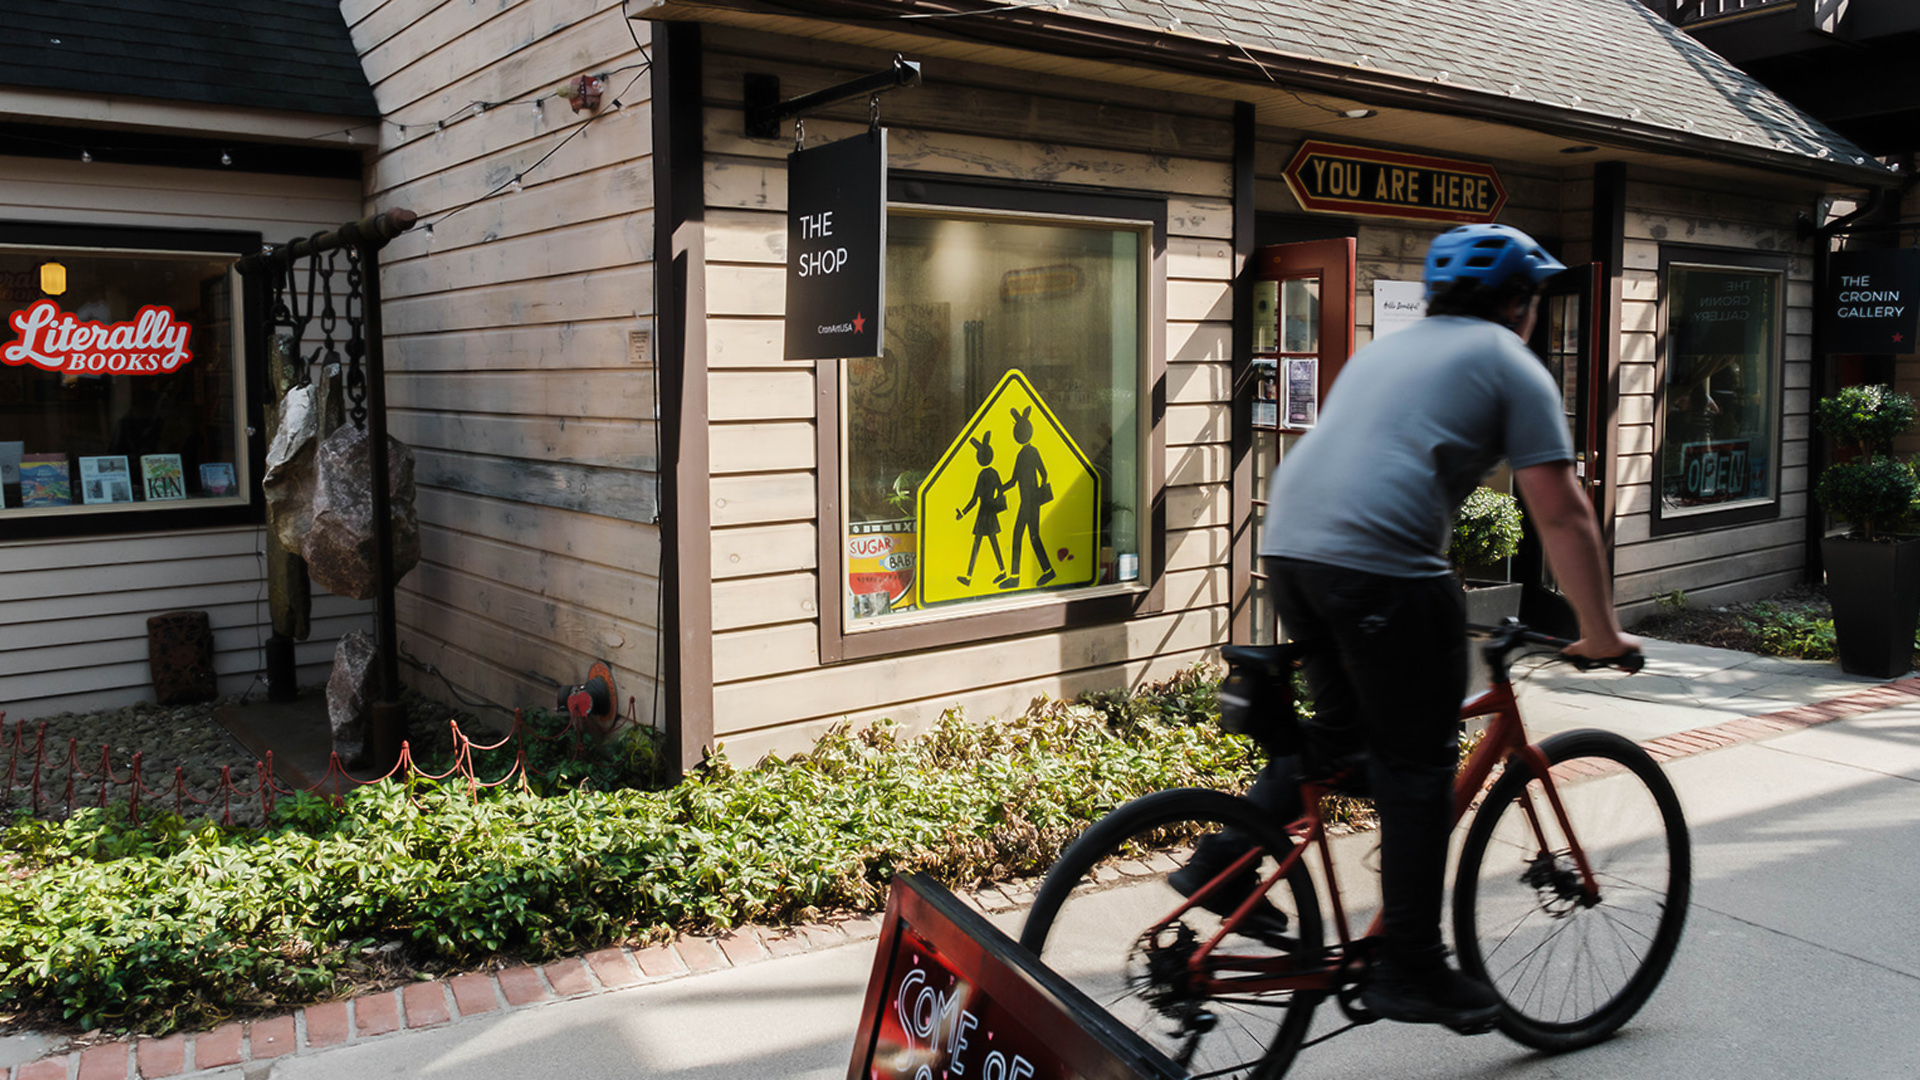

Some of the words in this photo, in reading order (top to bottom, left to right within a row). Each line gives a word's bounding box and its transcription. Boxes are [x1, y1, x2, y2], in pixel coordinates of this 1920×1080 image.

[1313, 159, 1360, 197] YOU
[1375, 167, 1419, 202] ARE
[1433, 174, 1488, 209] HERE
[800, 211, 833, 240] THE
[798, 247, 848, 277] SHOP
[1841, 275, 1870, 287] THE
[1839, 291, 1900, 302] CRONIN
[1837, 306, 1905, 318] GALLERY
[5, 303, 188, 369] Literally
[818, 323, 853, 334] CronArtUSA
[67, 353, 160, 371] BOOKS
[1687, 451, 1746, 497] OPEN
[146, 476, 183, 498] KIN
[850, 537, 893, 554] SUGAR
[889, 554, 917, 569] BABY
[894, 968, 979, 1076] SOME
